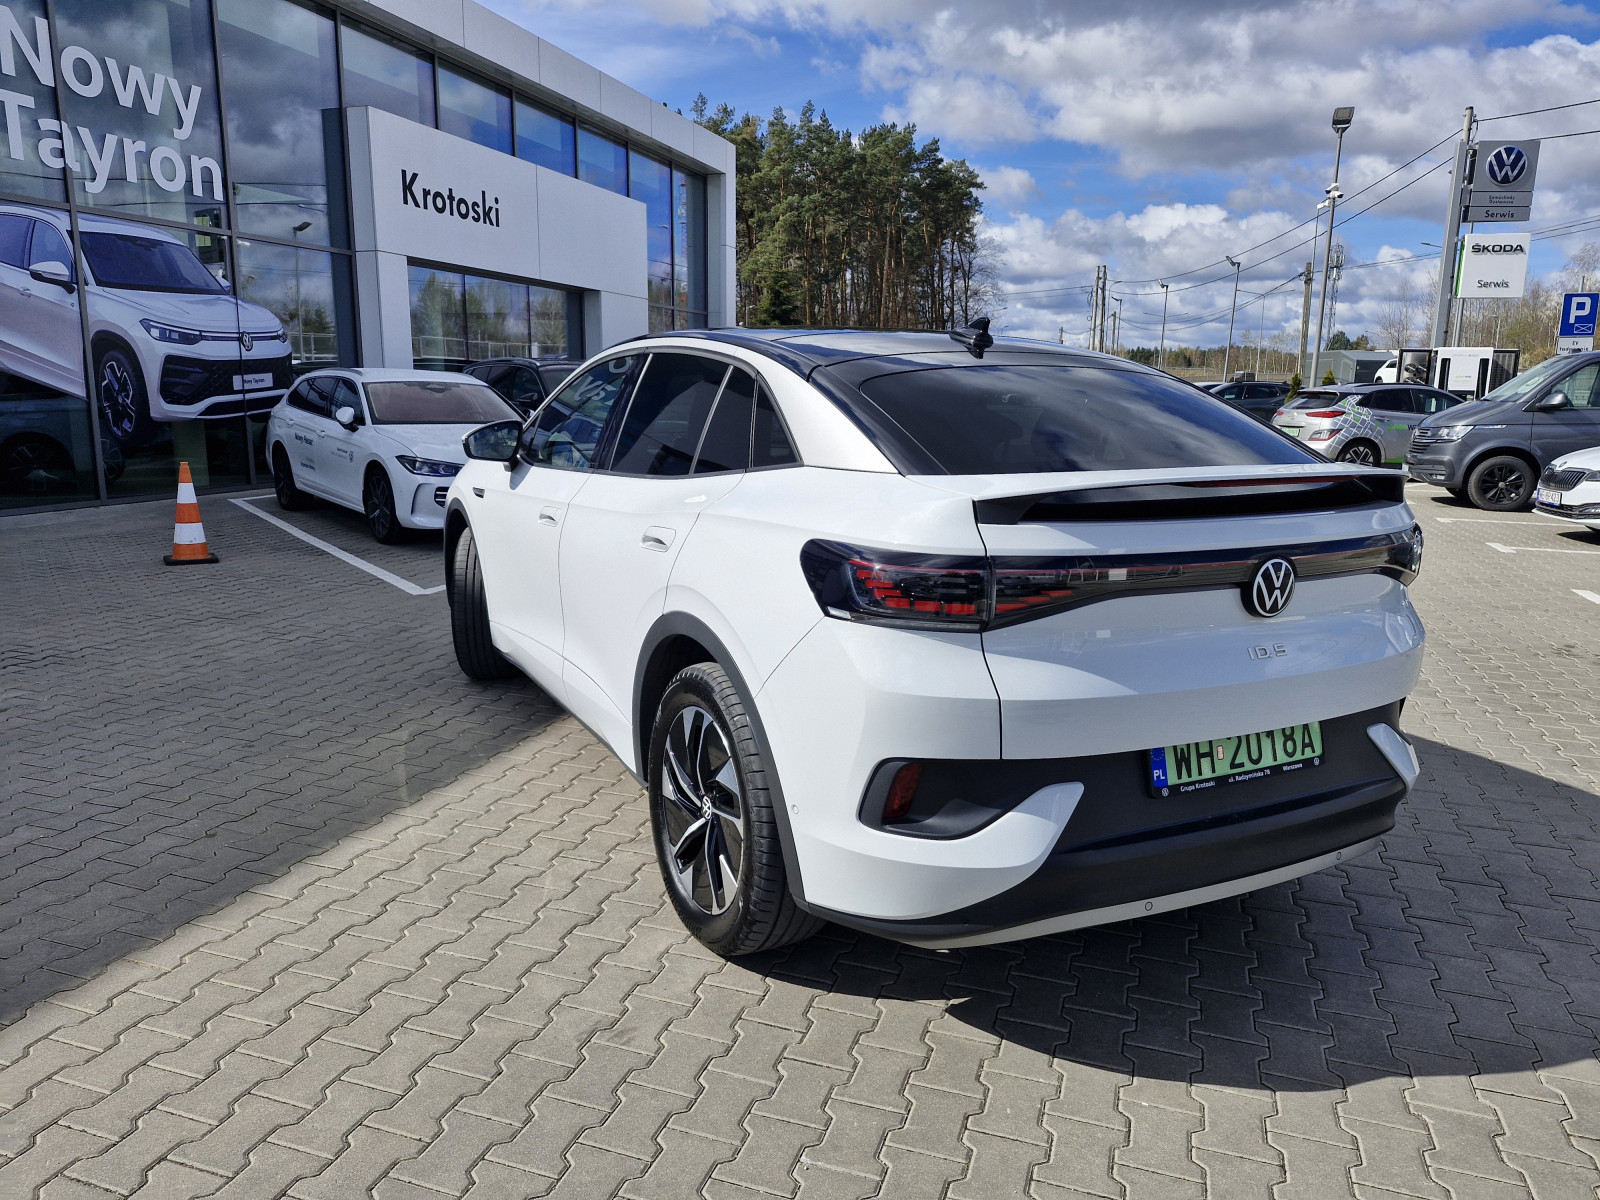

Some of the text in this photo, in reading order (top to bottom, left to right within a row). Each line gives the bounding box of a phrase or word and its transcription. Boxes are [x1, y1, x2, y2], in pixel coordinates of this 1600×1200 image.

[0, 4, 202, 140] Nowy
[0, 88, 224, 201] Tayron
[401, 169, 500, 228] Krotoski
[1484, 210, 1515, 218] Serwis
[1471, 243, 1525, 253] ŠKODA
[1477, 279, 1510, 288] Serwis
[1569, 296, 1591, 323] P
[1172, 740, 1217, 781] WH
[1153, 769, 1166, 780] PL
[1180, 784, 1196, 792] Grupa
[1195, 780, 1216, 789] Krotoski
